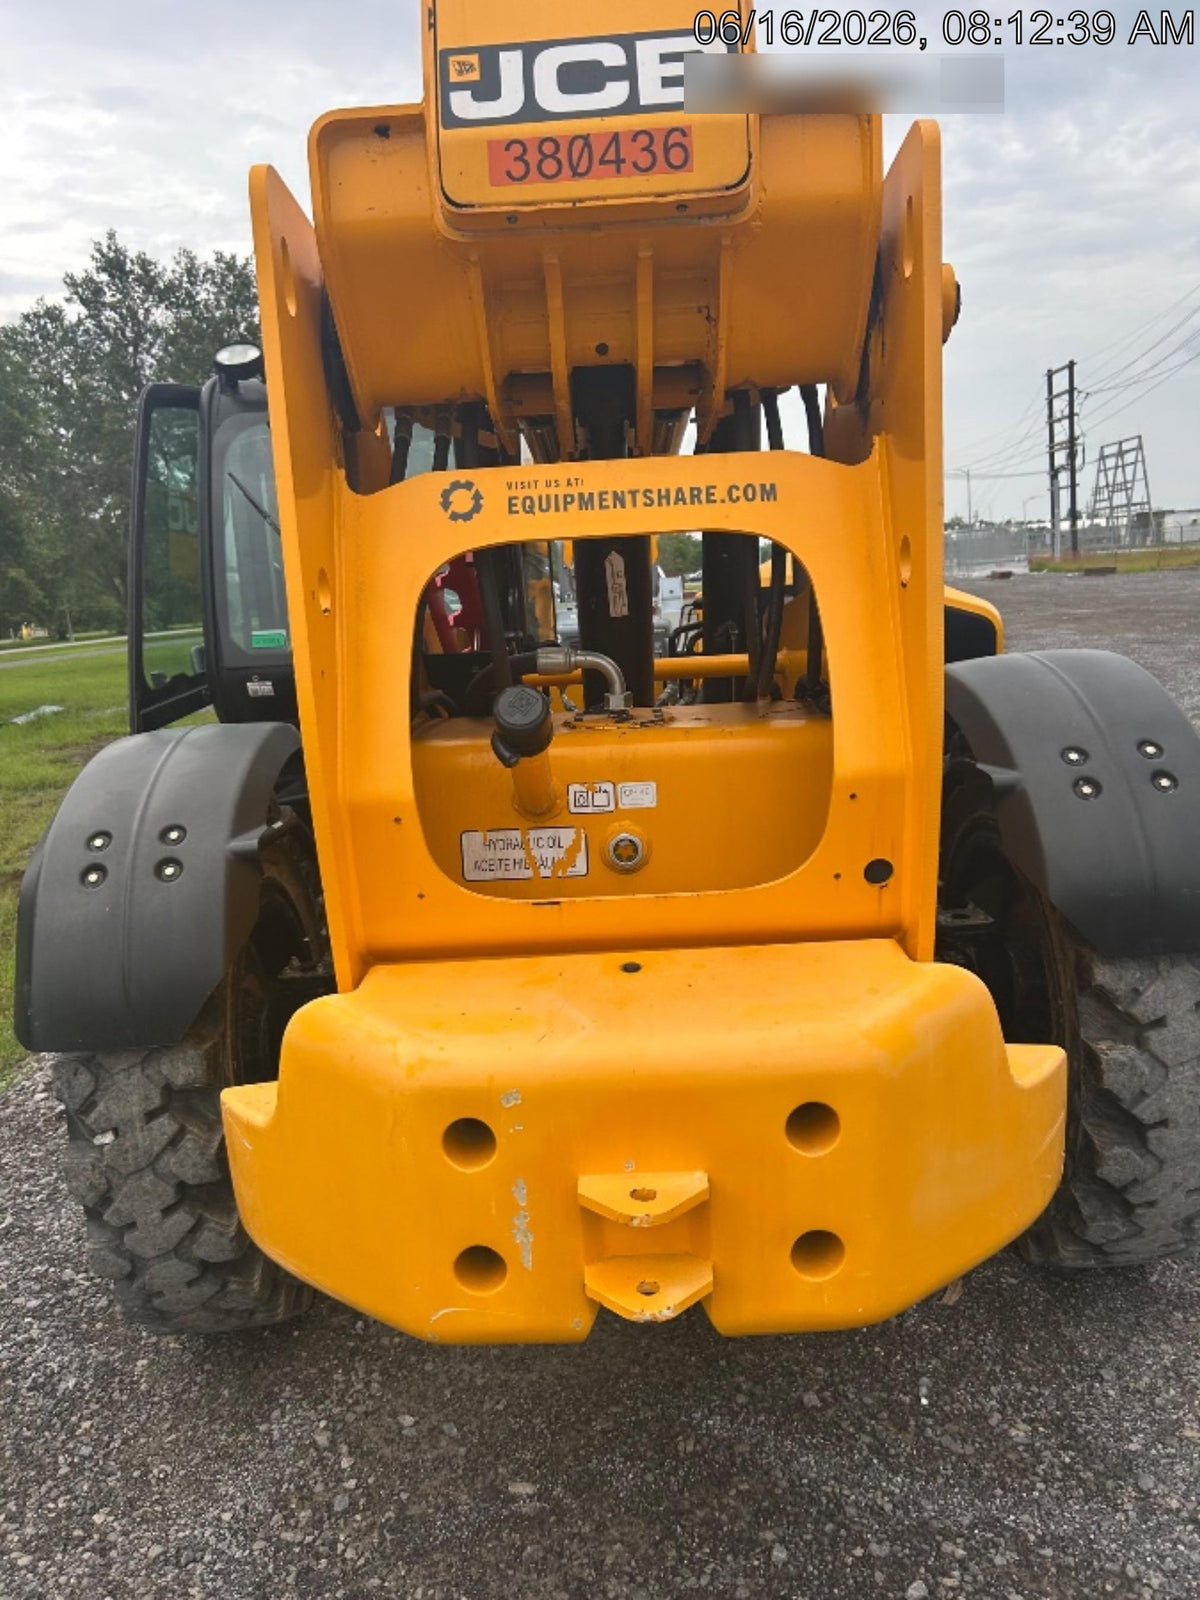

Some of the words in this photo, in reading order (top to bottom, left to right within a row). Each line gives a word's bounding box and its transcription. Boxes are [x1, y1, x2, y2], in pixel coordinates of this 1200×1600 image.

[504, 127, 691, 182] 380436
[506, 480, 539, 490] VISIT
[545, 479, 560, 488] US
[507, 482, 778, 516] EQUIPMENTSHARE.COM
